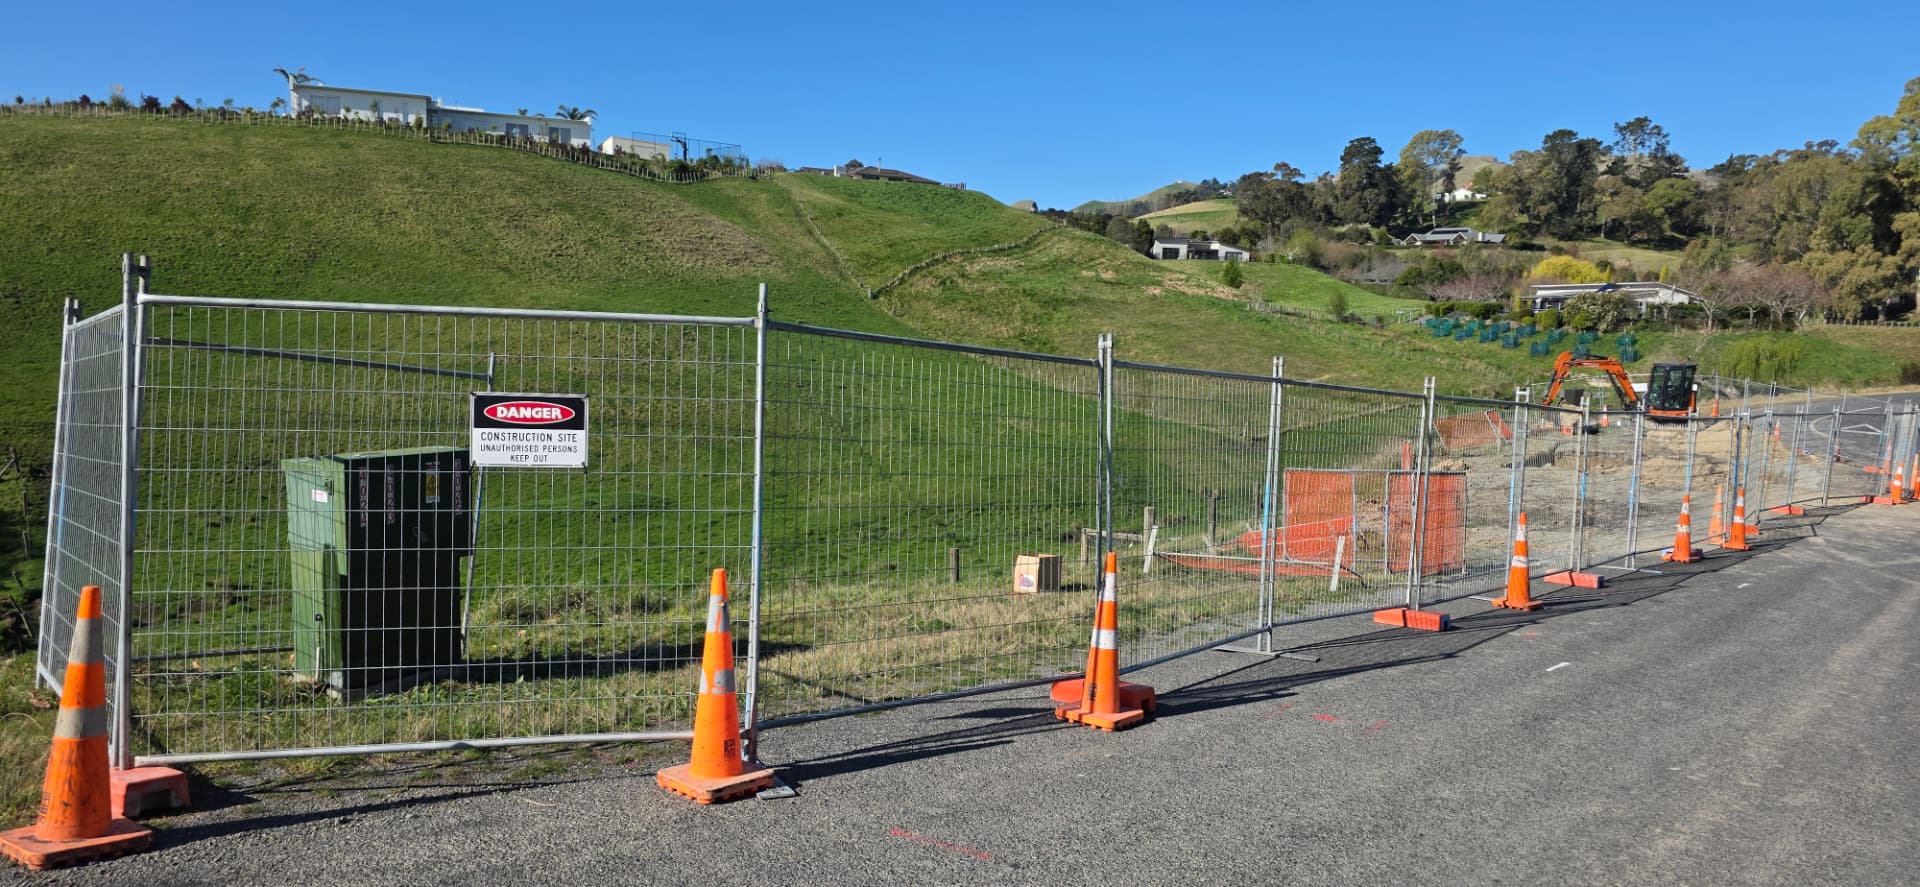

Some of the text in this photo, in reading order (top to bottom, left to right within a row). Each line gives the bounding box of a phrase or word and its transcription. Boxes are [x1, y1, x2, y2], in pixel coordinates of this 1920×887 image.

[496, 406, 562, 419] DANGER
[481, 432, 578, 443] CONSTRUCTION SITE
[480, 444, 578, 453] UNAUTHORISED PERSONS
[510, 454, 548, 463] KEEP OUT
